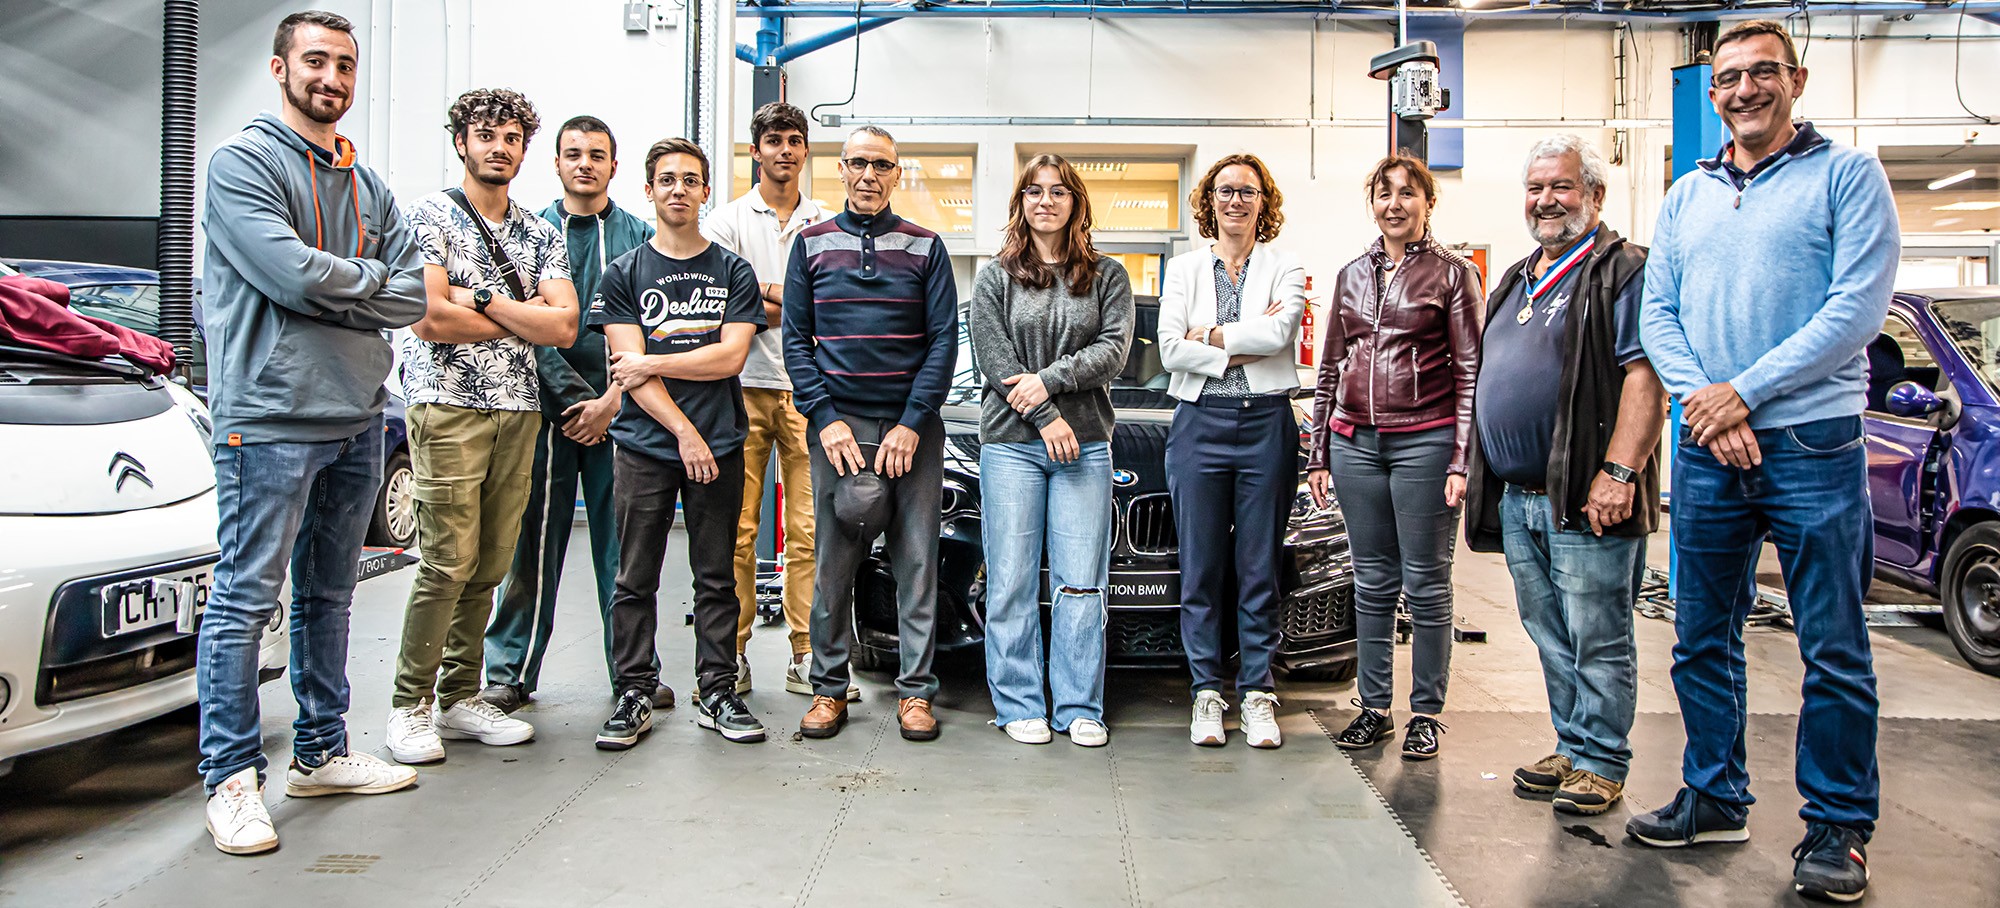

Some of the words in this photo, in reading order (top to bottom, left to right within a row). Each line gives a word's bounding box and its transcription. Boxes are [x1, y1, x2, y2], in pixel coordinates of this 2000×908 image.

[656, 273, 715, 286] WORLDWIDE
[708, 288, 726, 296] 1974
[640, 287, 726, 327] Deeluxe
[1109, 584, 1135, 595] TION
[1138, 584, 1167, 595] BMW
